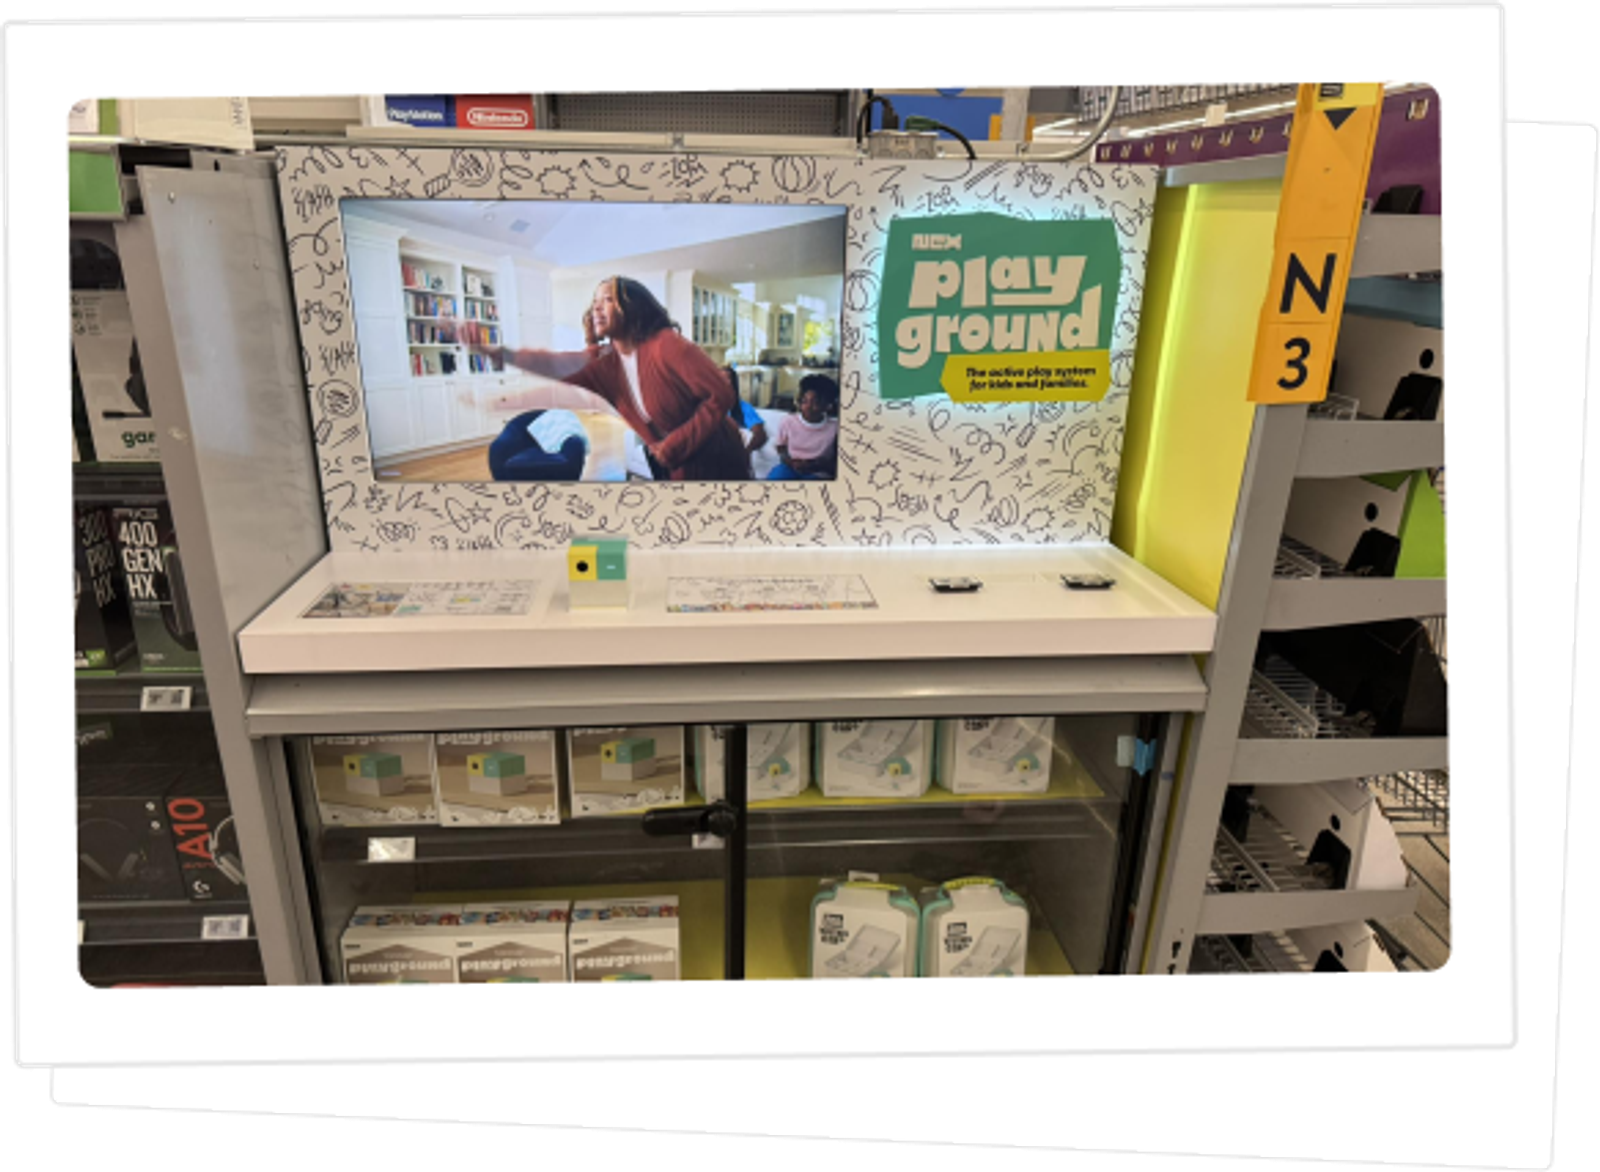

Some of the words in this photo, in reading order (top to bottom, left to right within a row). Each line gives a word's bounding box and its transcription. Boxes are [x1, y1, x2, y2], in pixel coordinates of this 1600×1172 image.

[472, 111, 523, 124] Nintendo
[908, 255, 1088, 309] play
[1279, 252, 1337, 314] N
[966, 367, 986, 378] The
[988, 366, 1024, 378] active
[1026, 365, 1053, 380] play
[1054, 365, 1097, 379] system
[1277, 336, 1311, 390] 3
[969, 379, 987, 393] for
[988, 379, 1013, 389] kids
[1015, 379, 1038, 389] and
[118, 521, 158, 548] 400
[122, 547, 163, 574] GEN
[126, 573, 158, 600] HX
[167, 798, 214, 861] A10
